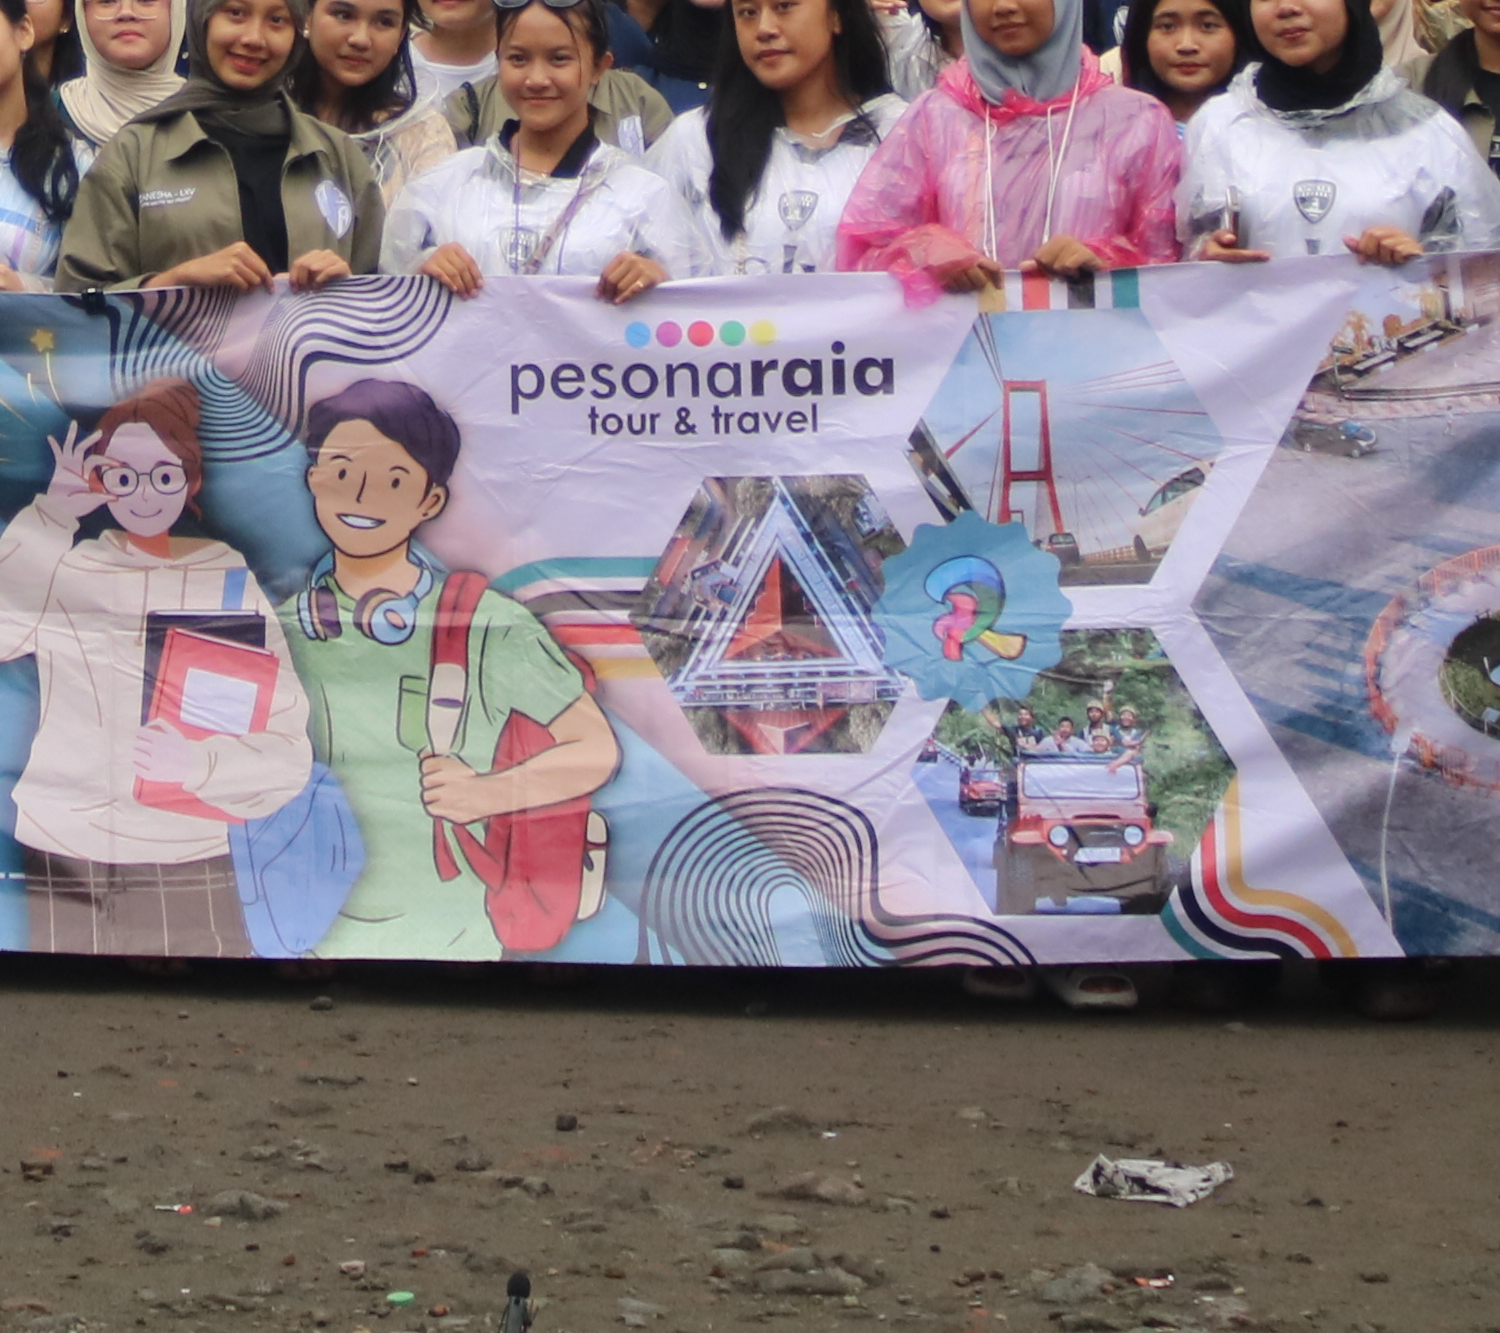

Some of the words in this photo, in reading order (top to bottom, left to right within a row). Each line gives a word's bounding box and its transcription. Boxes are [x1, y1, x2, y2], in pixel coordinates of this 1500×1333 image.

[510, 340, 896, 415] pesonaraia
[588, 406, 661, 435] tour
[674, 407, 698, 435] &
[711, 402, 819, 435] travel
